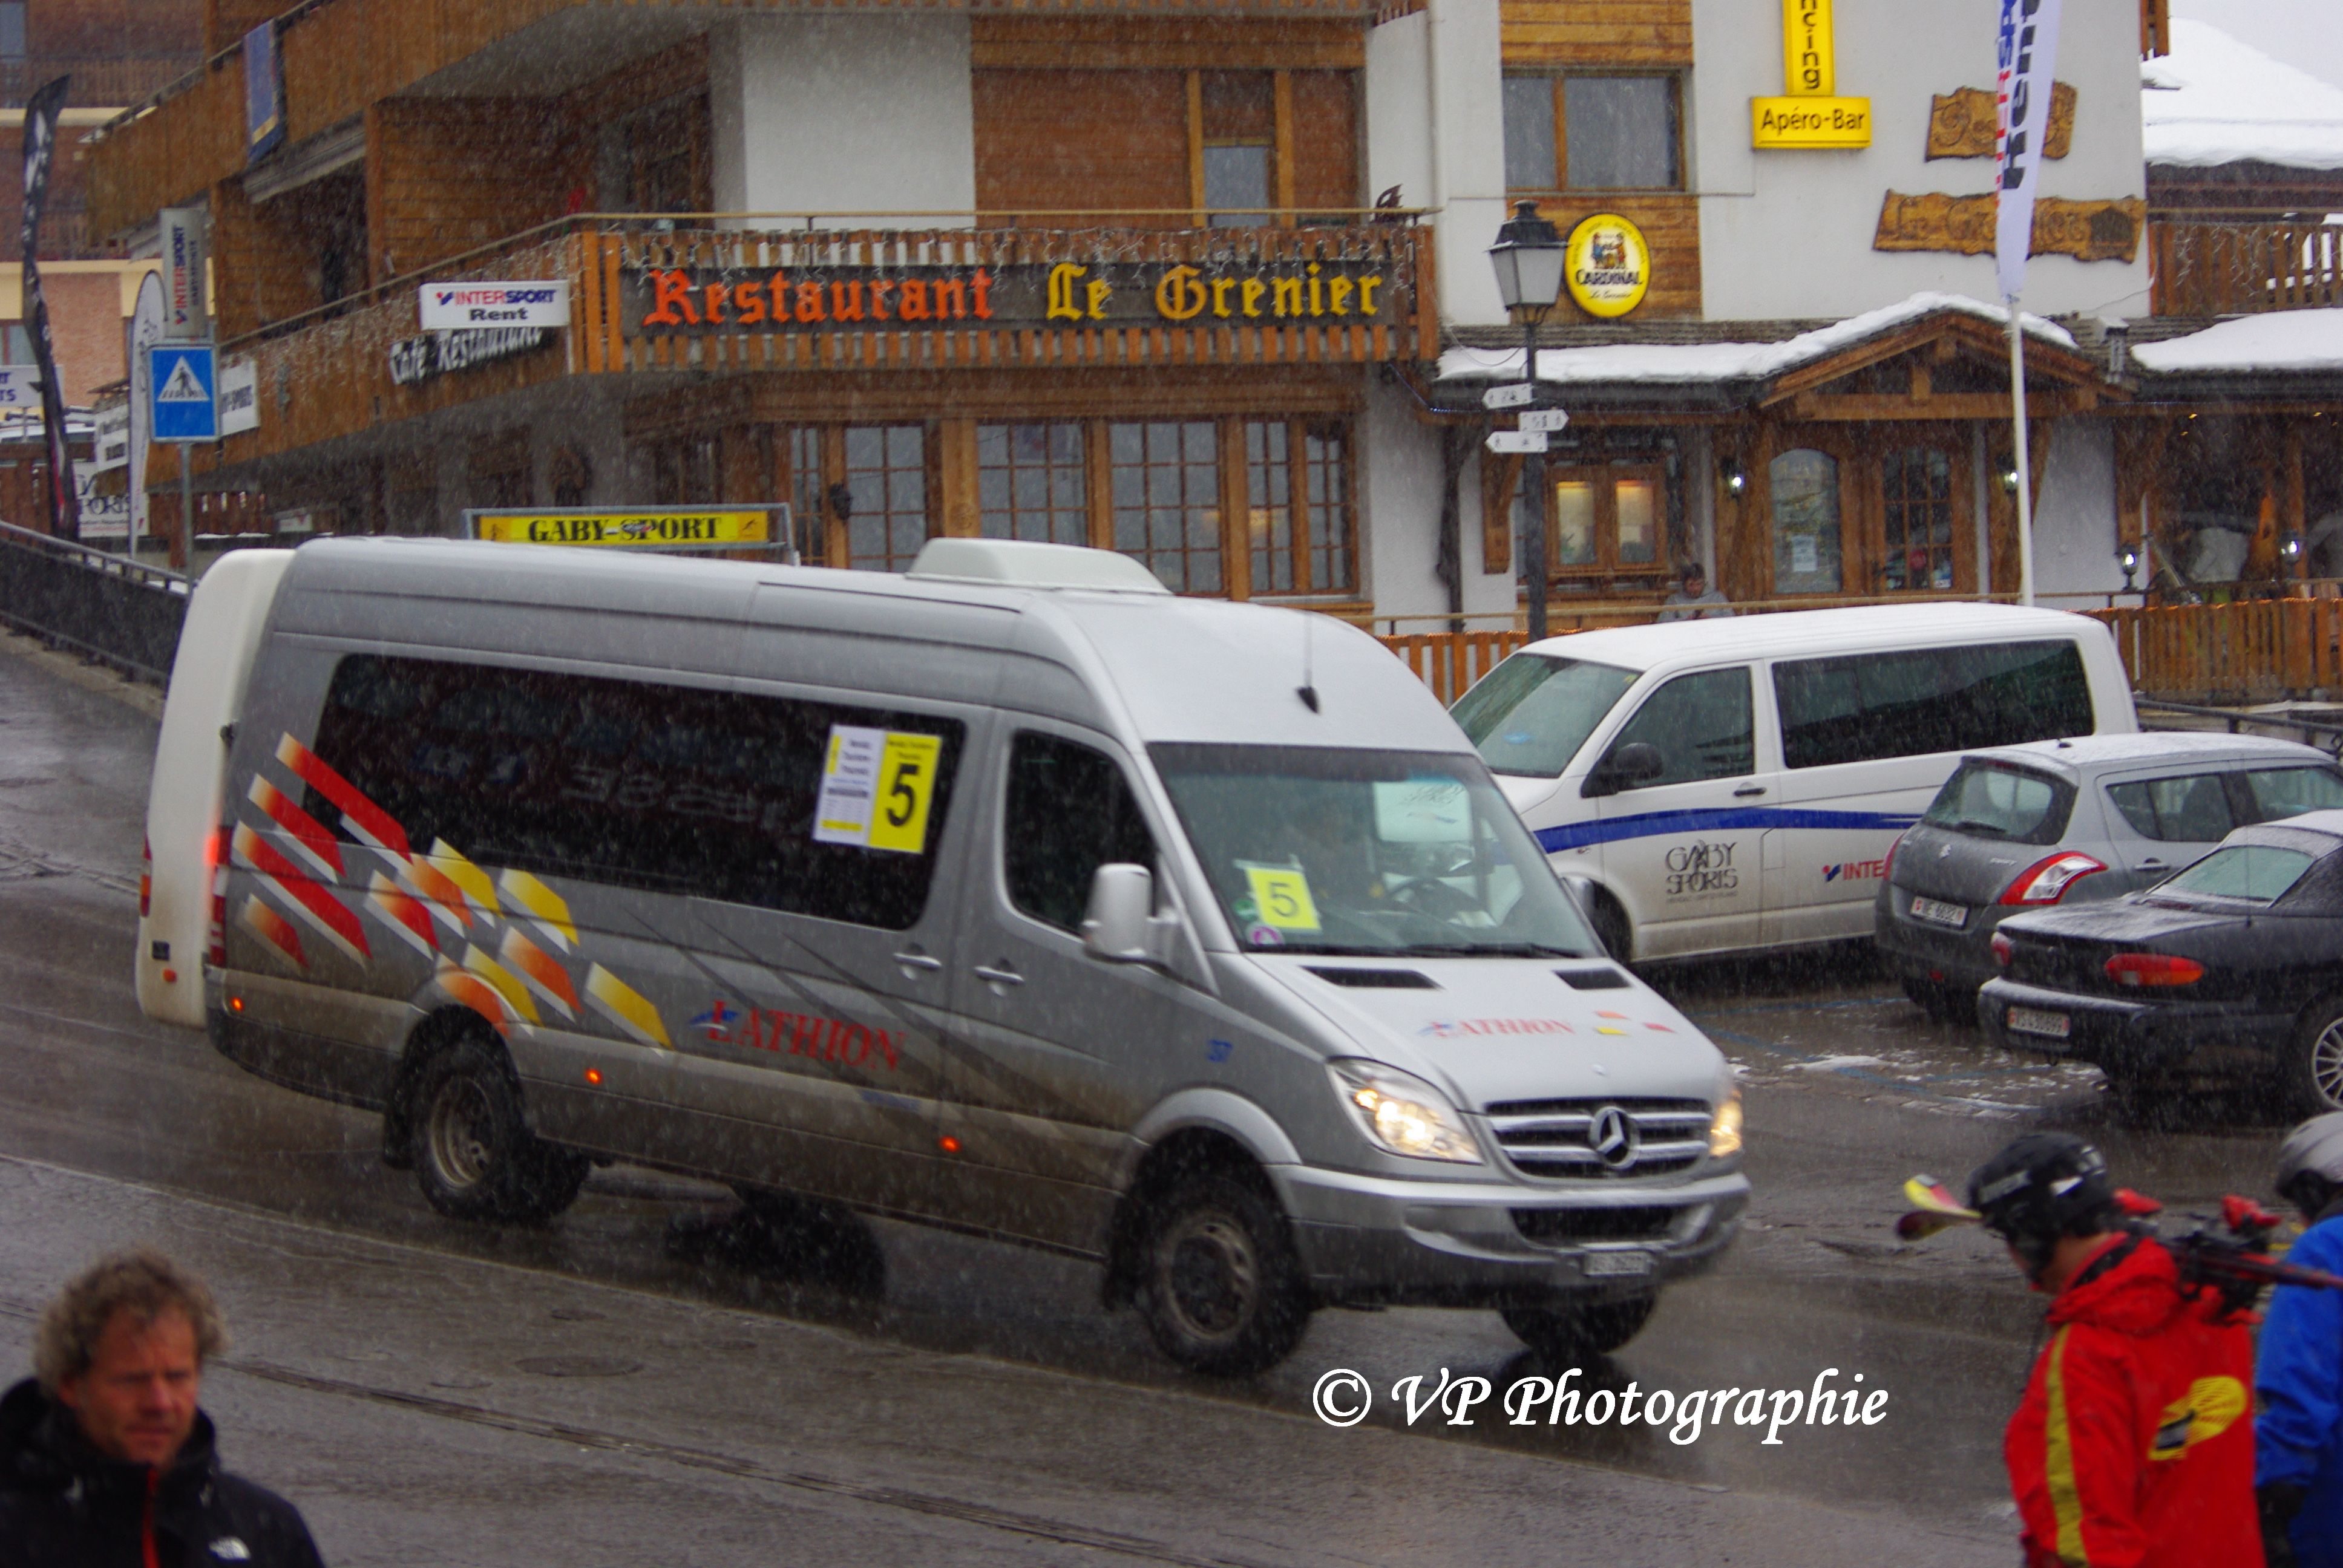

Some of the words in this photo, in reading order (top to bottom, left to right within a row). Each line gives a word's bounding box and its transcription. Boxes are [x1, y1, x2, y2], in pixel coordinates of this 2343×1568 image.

[1761, 106, 1866, 136] Apéro-Bar
[172, 227, 187, 309] INTERSPORT
[1576, 269, 1643, 286] CARDINAL
[455, 289, 556, 305] INTERSPORT
[643, 267, 993, 326] Restaurant
[1047, 262, 1112, 321] Le
[1155, 261, 1383, 321] Grenier
[469, 308, 528, 321] Rent
[528, 517, 721, 542] GABY-SPORT
[886, 762, 920, 828] 5
[1666, 840, 1737, 871] GABY
[1267, 881, 1300, 918] 5
[707, 1000, 905, 1071] LATHION
